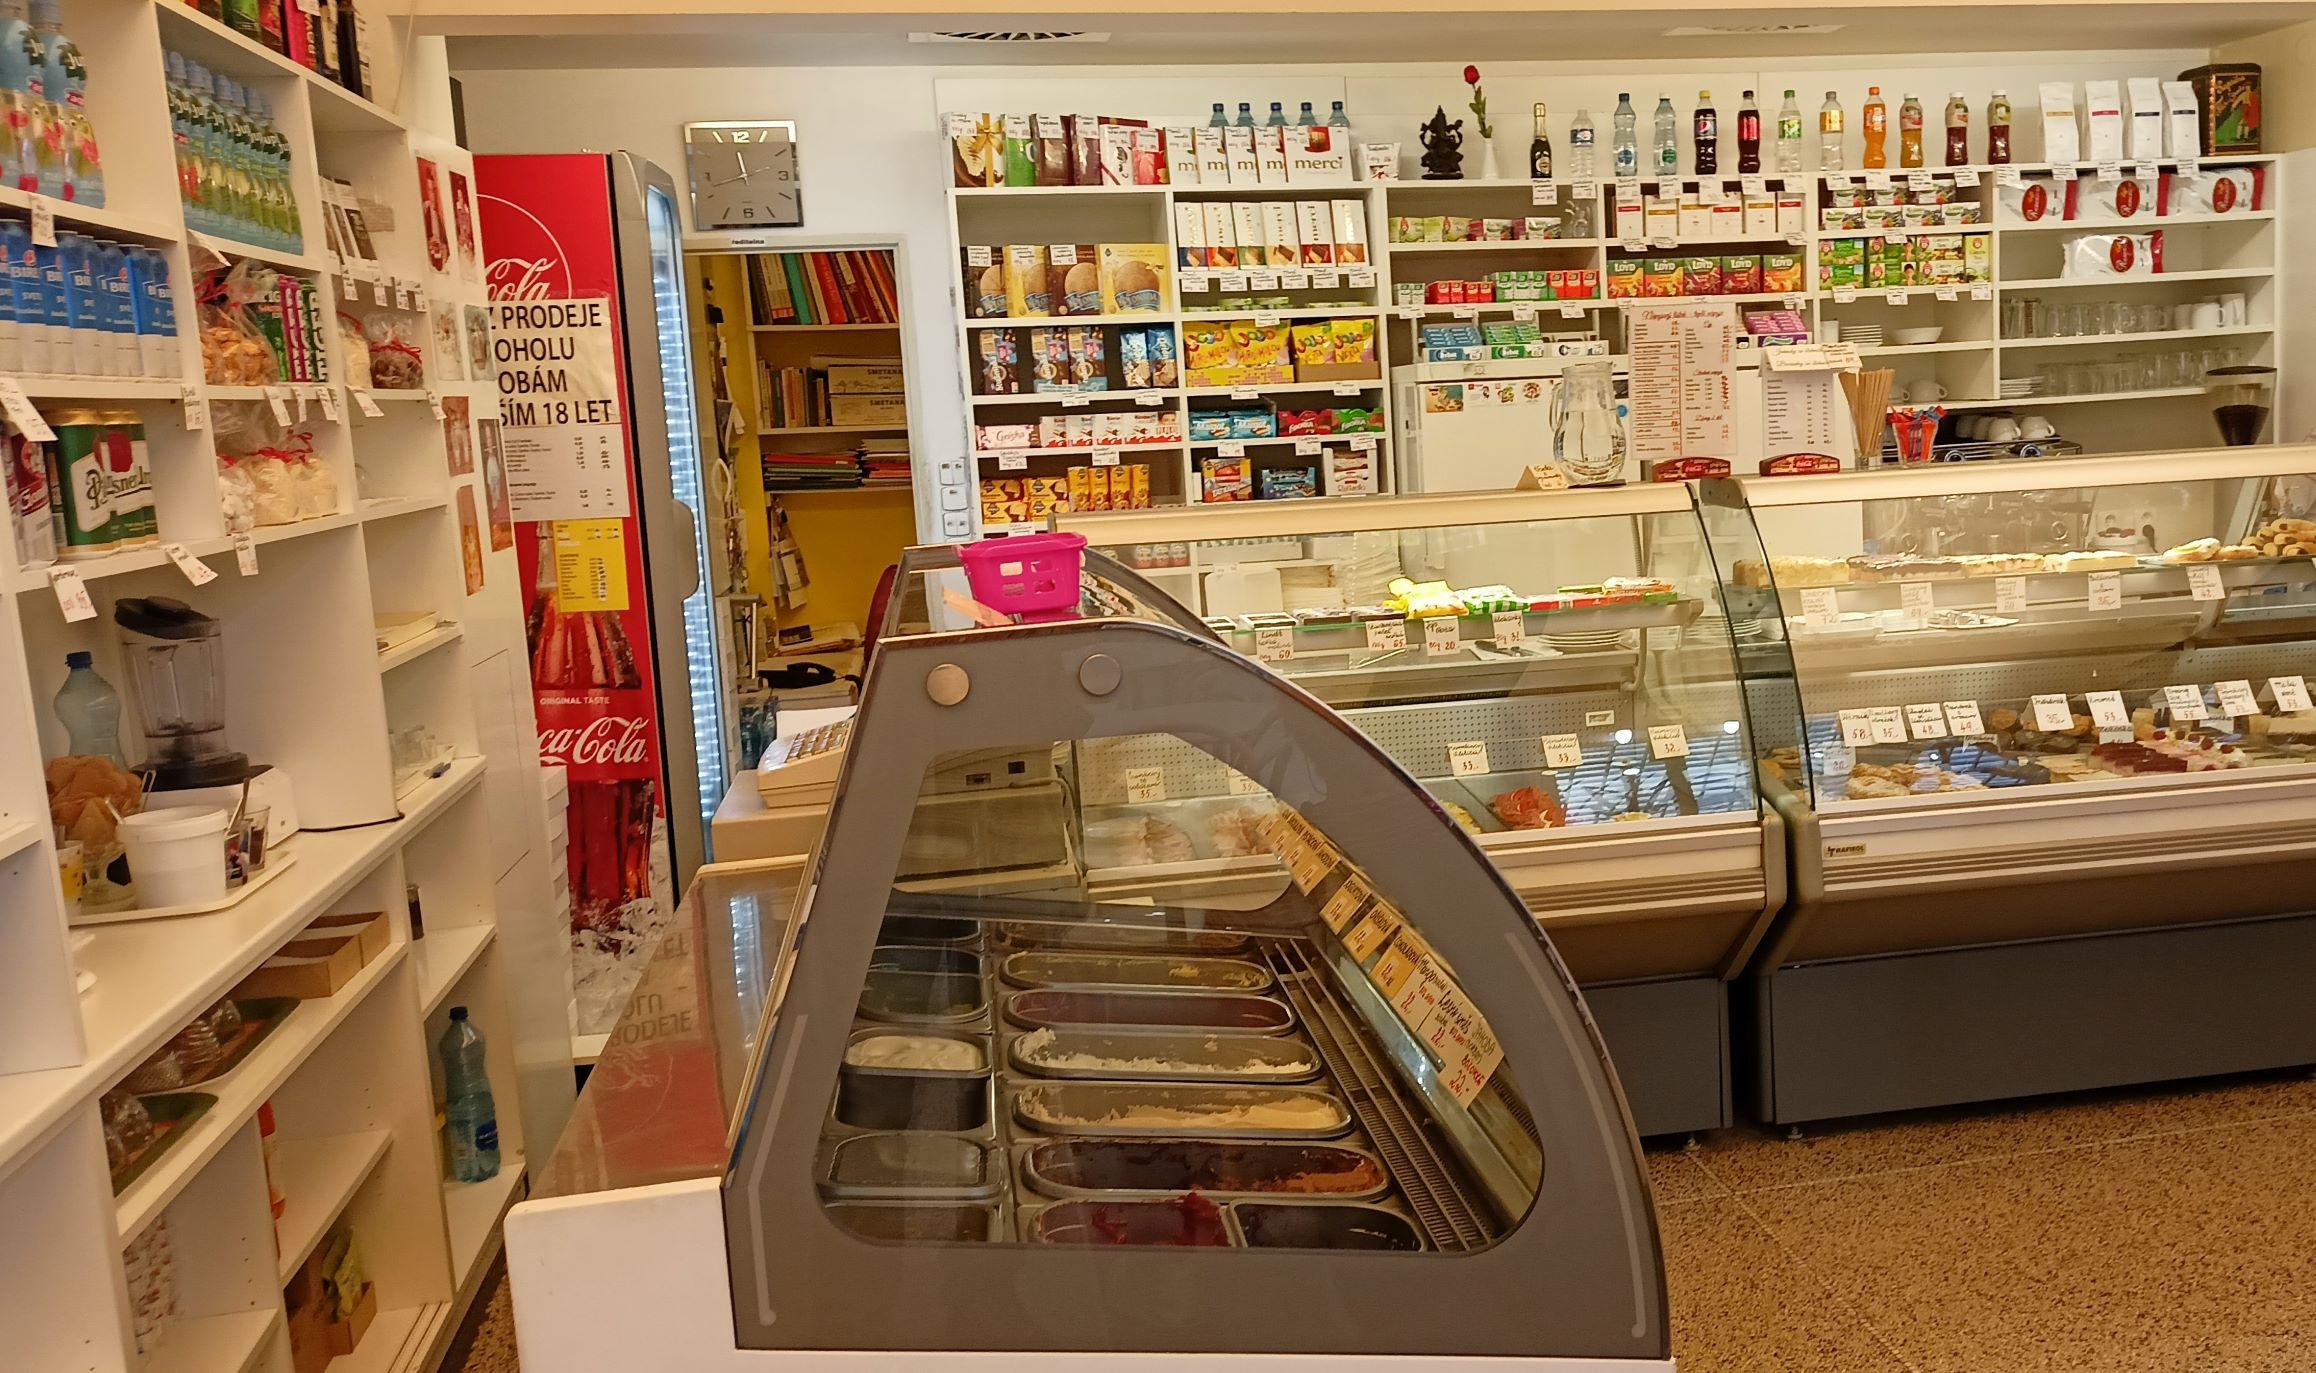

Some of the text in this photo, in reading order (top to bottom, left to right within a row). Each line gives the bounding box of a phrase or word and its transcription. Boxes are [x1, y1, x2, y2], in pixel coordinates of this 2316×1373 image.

[731, 131, 750, 143] 12
[1295, 158, 1344, 170] merci
[778, 170, 790, 181] 3
[743, 207, 754, 219] 6
[1614, 263, 1636, 272] LOYD
[1654, 262, 1676, 271] LOYD
[1692, 260, 1714, 269] LOYD
[1731, 259, 1752, 268] LOYD
[1772, 257, 1793, 267] LOYD
[501, 303, 603, 330] PRODEJE
[494, 337, 576, 363] OHOLU
[498, 365, 568, 394] OBÁM
[500, 398, 612, 426] ŠÍM 18 LET
[540, 697, 582, 705] ORIGINAL
[538, 716, 650, 765] ca-Cola
